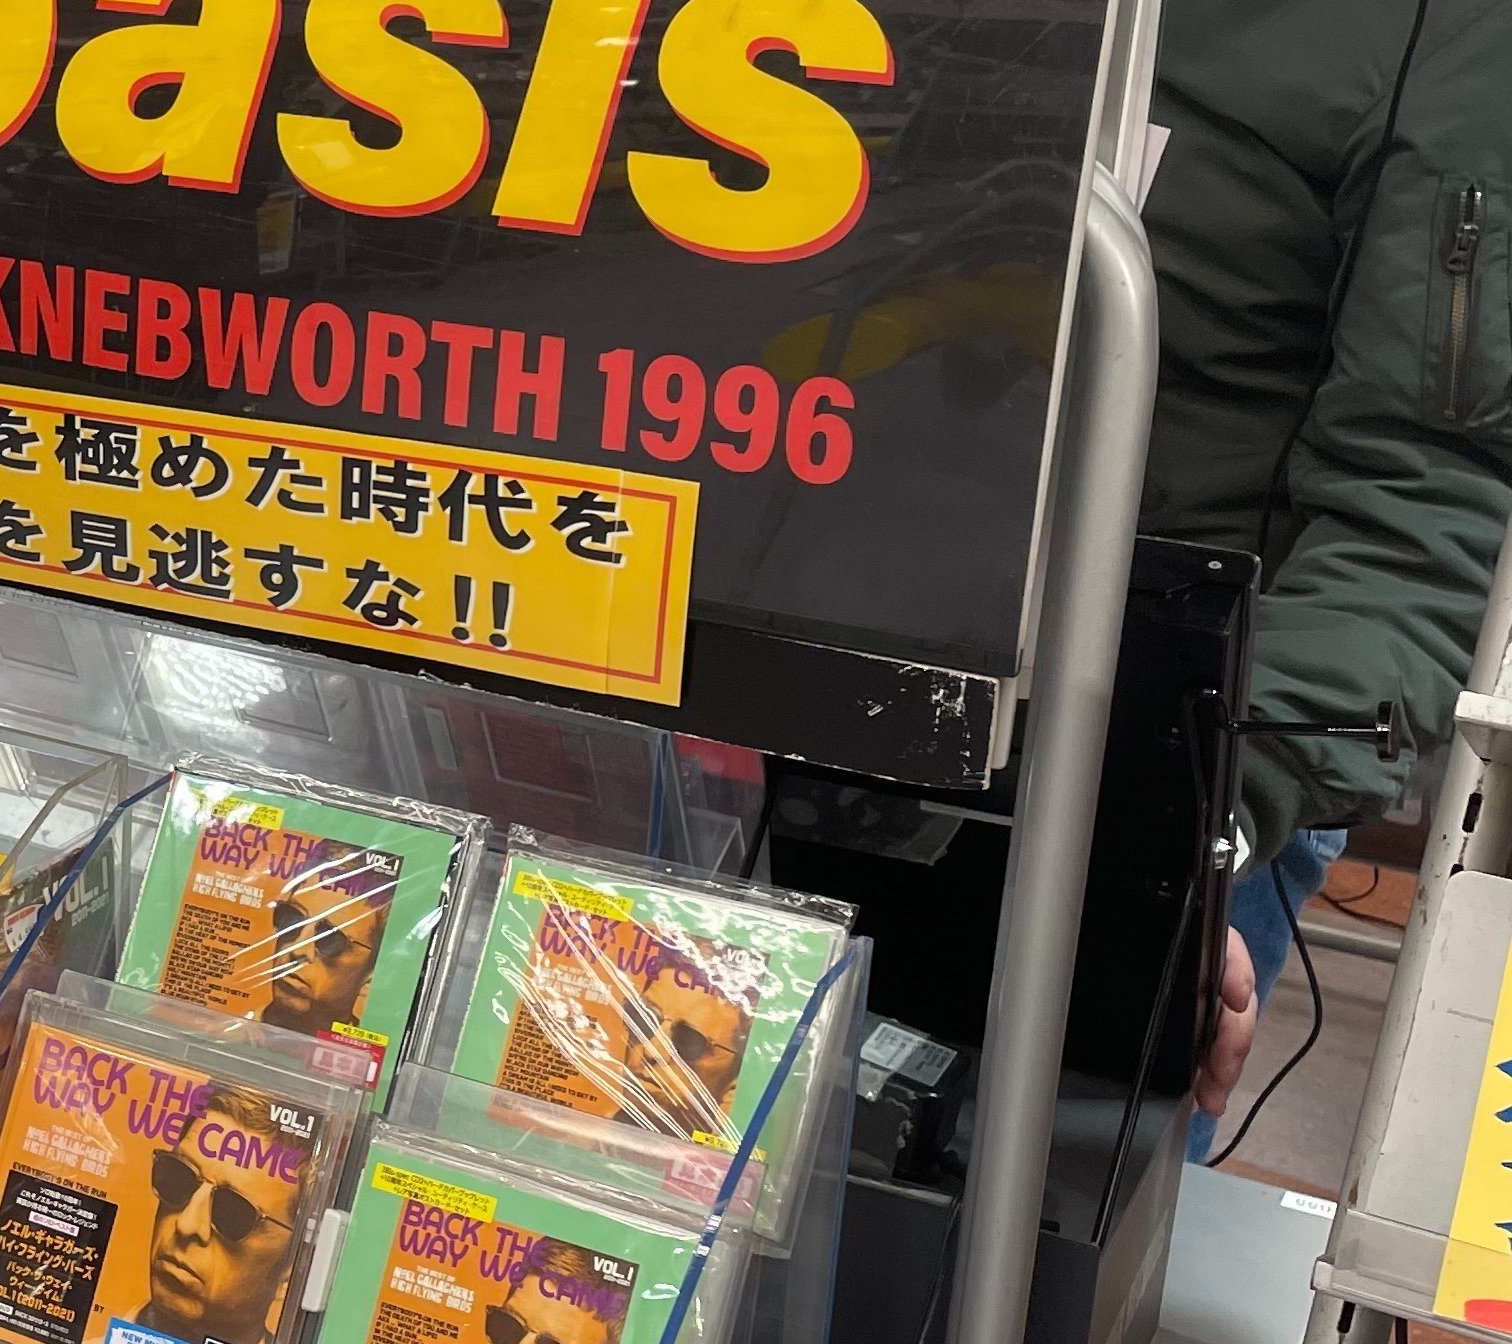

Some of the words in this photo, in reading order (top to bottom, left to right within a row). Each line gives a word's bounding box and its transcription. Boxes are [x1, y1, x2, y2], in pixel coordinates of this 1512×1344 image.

[600, 347, 856, 485] 1996
[40, 1038, 134, 1095] BACK
[148, 1068, 215, 1118] THE
[34, 1069, 116, 1119] WAY
[127, 1098, 193, 1148] WE
[197, 1122, 301, 1185] CAME
[269, 1103, 315, 1135] VOL.1
[403, 1199, 484, 1246] BACK
[399, 1225, 469, 1268] WAY
[121, 1330, 144, 1344] NEW
